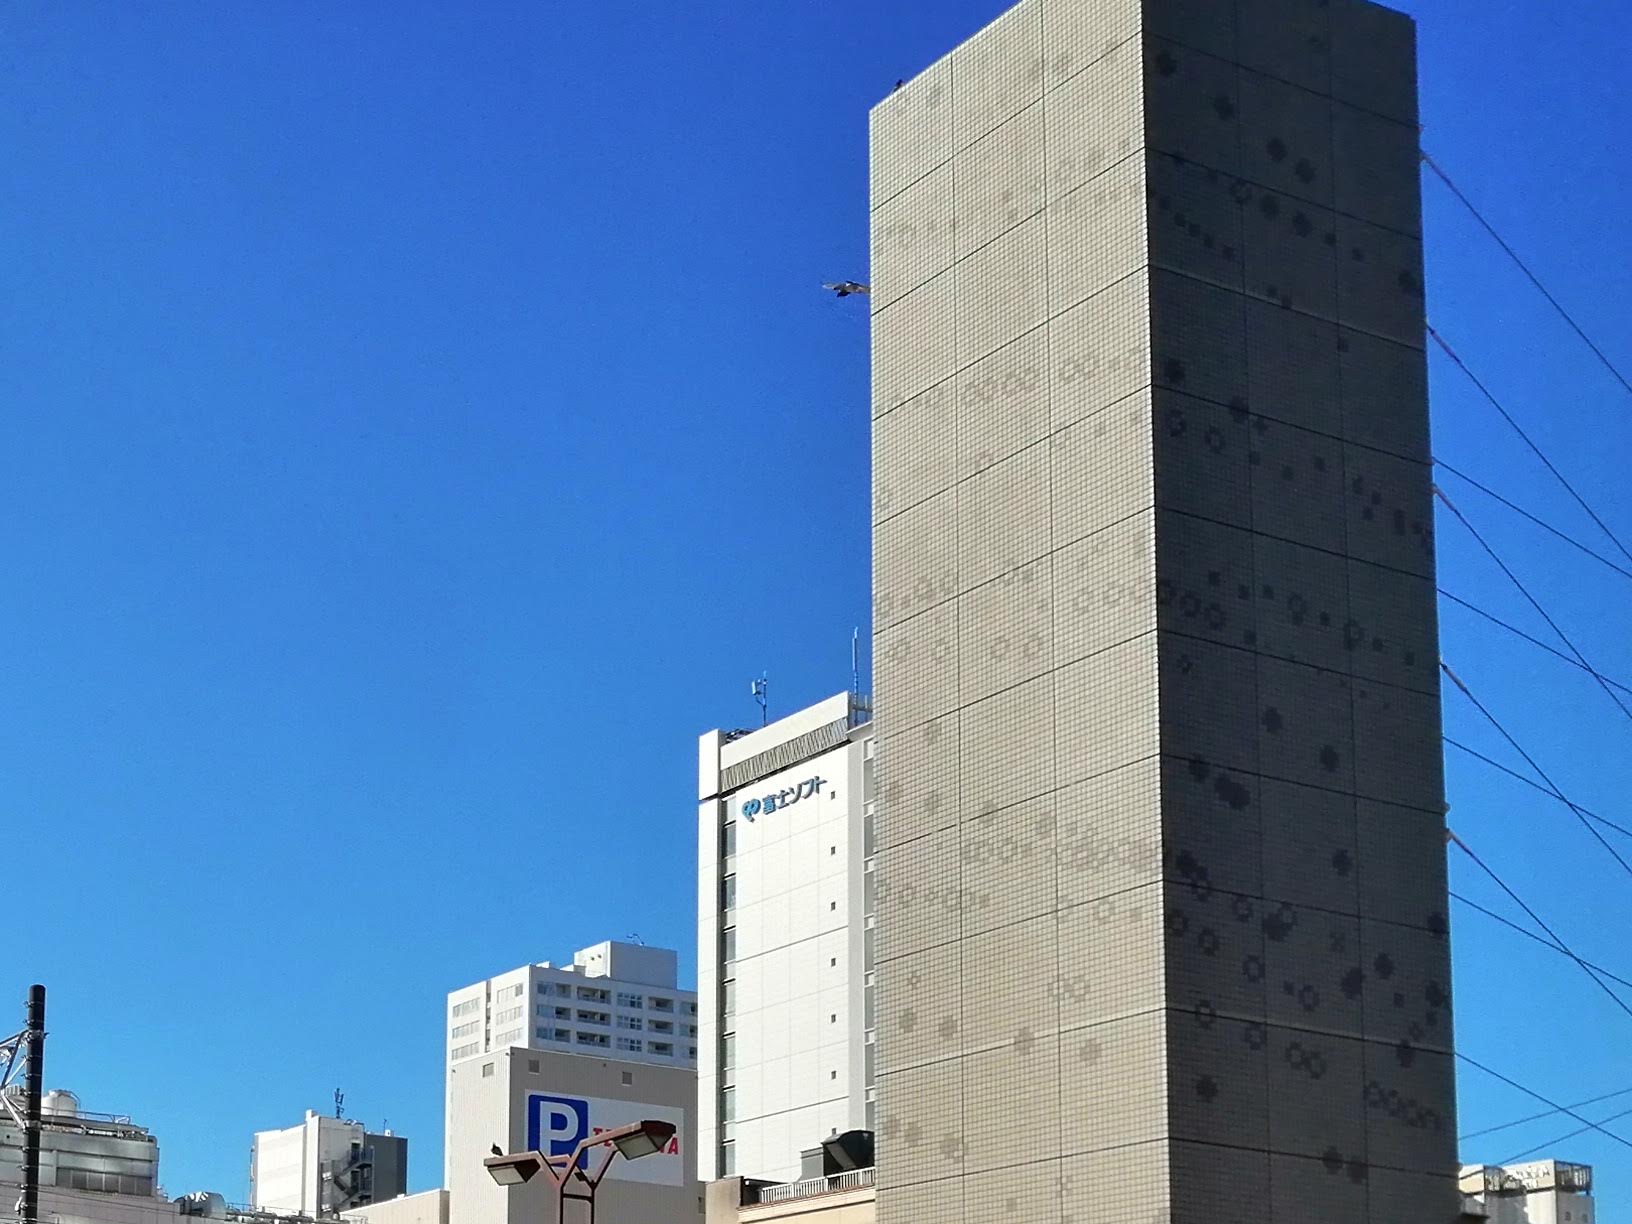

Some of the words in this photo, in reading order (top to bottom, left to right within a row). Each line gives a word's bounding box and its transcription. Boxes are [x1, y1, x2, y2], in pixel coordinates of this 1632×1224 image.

[762, 776, 827, 815] 富士ソフト
